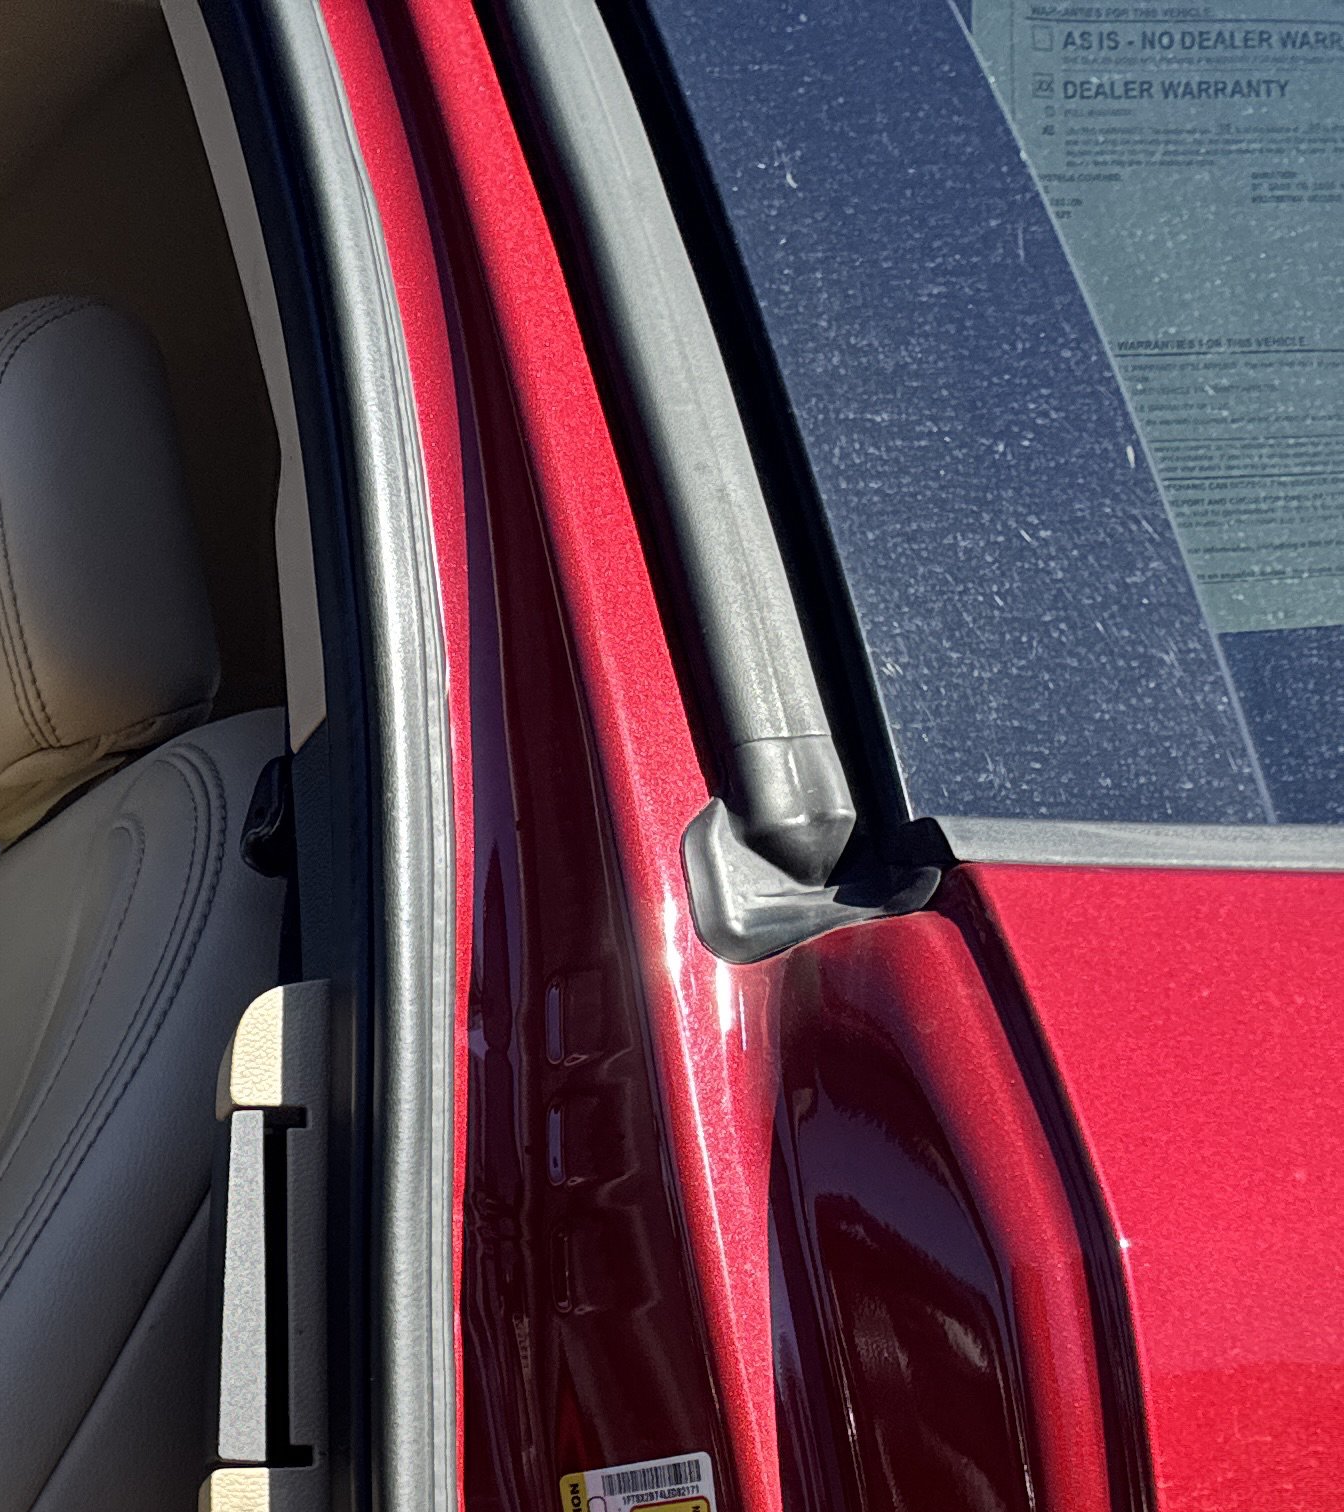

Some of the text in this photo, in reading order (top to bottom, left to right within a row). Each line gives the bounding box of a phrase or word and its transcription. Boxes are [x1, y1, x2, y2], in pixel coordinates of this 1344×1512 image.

[1062, 31, 1093, 50] AS
[1098, 31, 1120, 50] IS
[1141, 31, 1174, 50] NO
[1181, 30, 1272, 50] DEALER
[1063, 79, 1290, 99] DEALER WARRANTY
